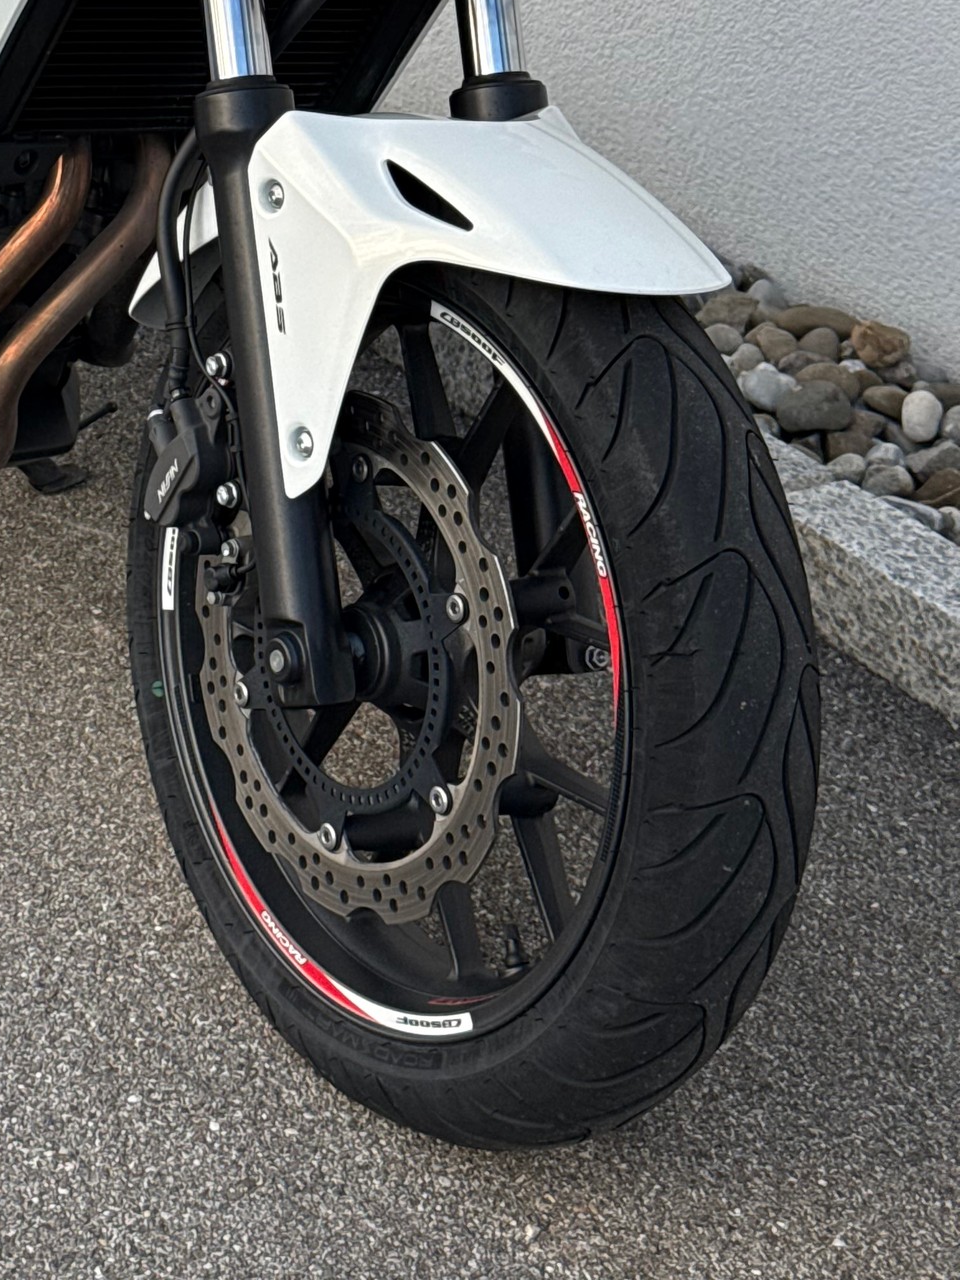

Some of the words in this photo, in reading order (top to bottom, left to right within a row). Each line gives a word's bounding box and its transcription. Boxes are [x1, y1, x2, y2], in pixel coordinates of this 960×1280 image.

[268, 237, 286, 335] ABS
[440, 311, 505, 366] CB500F
[573, 491, 608, 578] RACING
[261, 910, 308, 965] RACING
[396, 1016, 462, 1029] CB500F
